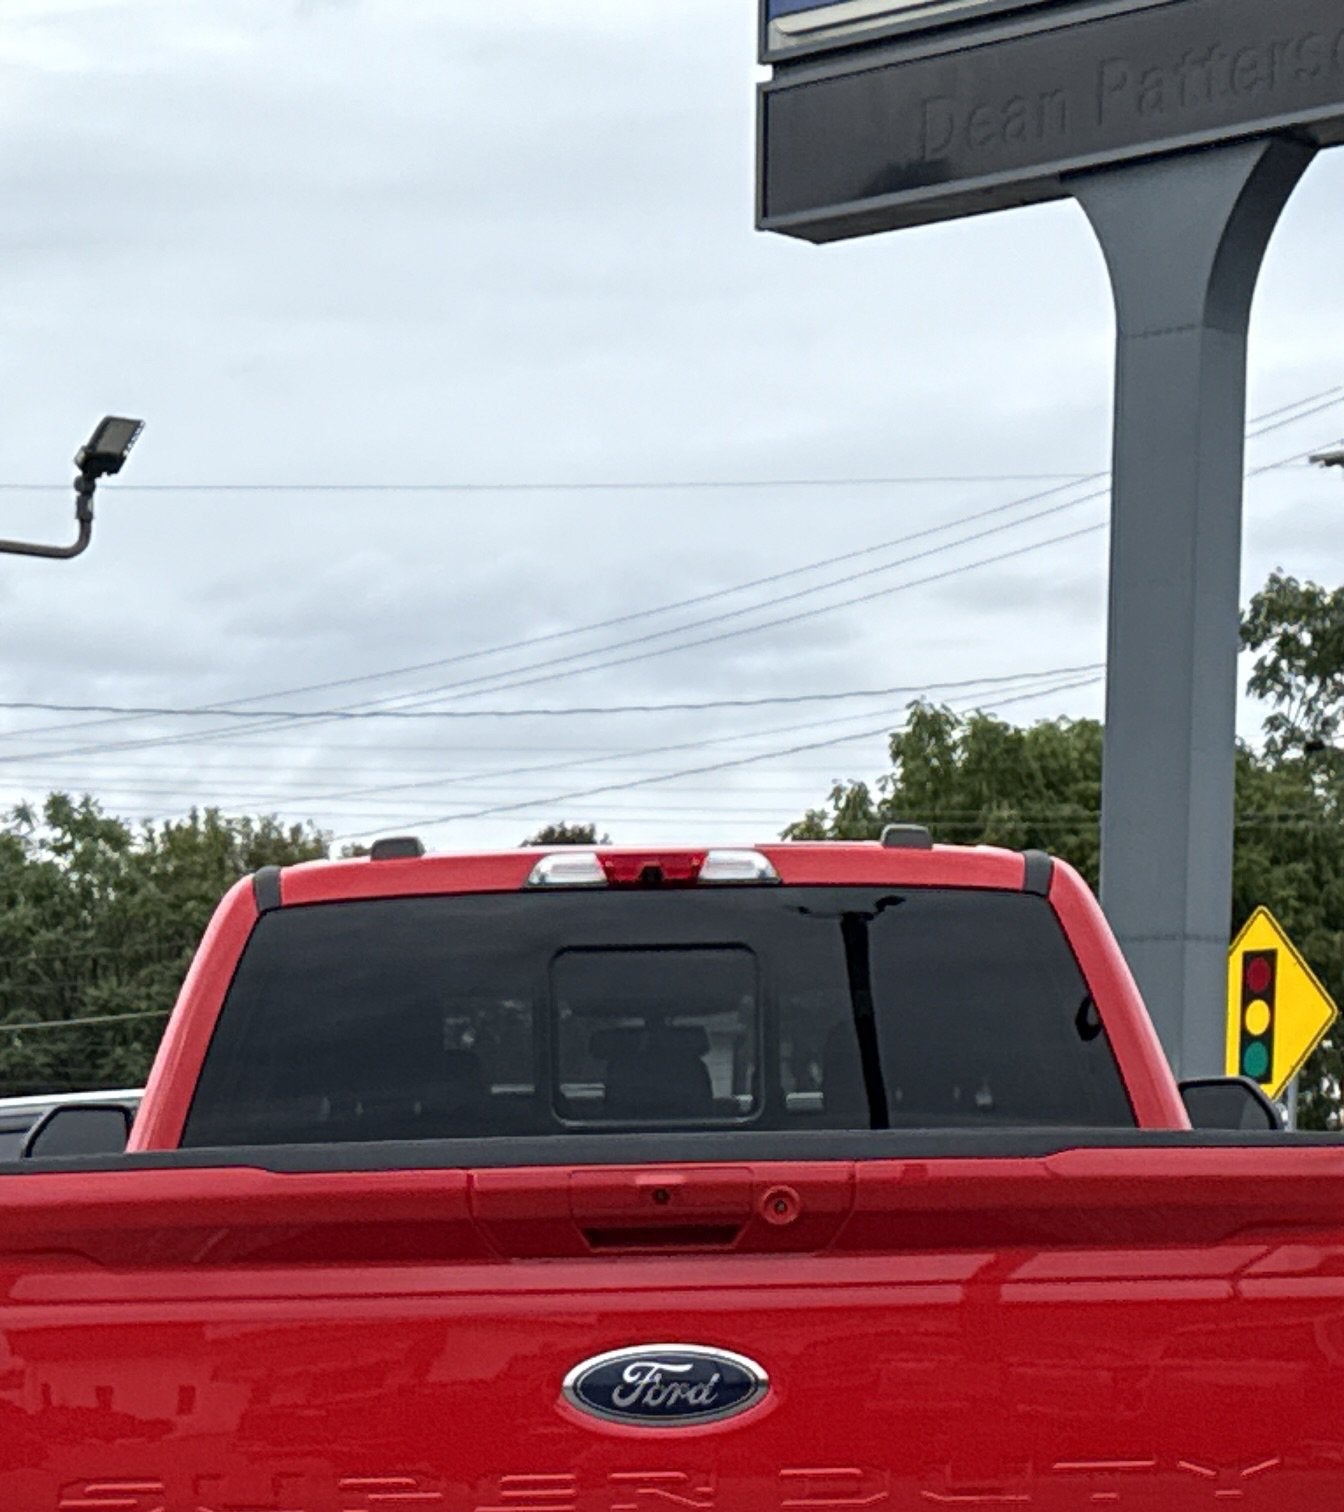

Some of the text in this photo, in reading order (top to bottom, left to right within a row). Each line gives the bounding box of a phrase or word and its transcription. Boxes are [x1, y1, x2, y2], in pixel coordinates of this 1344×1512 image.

[917, 88, 1067, 163] Dean
[611, 1360, 721, 1408] Ford
[778, 1457, 1281, 1506] DUTY
